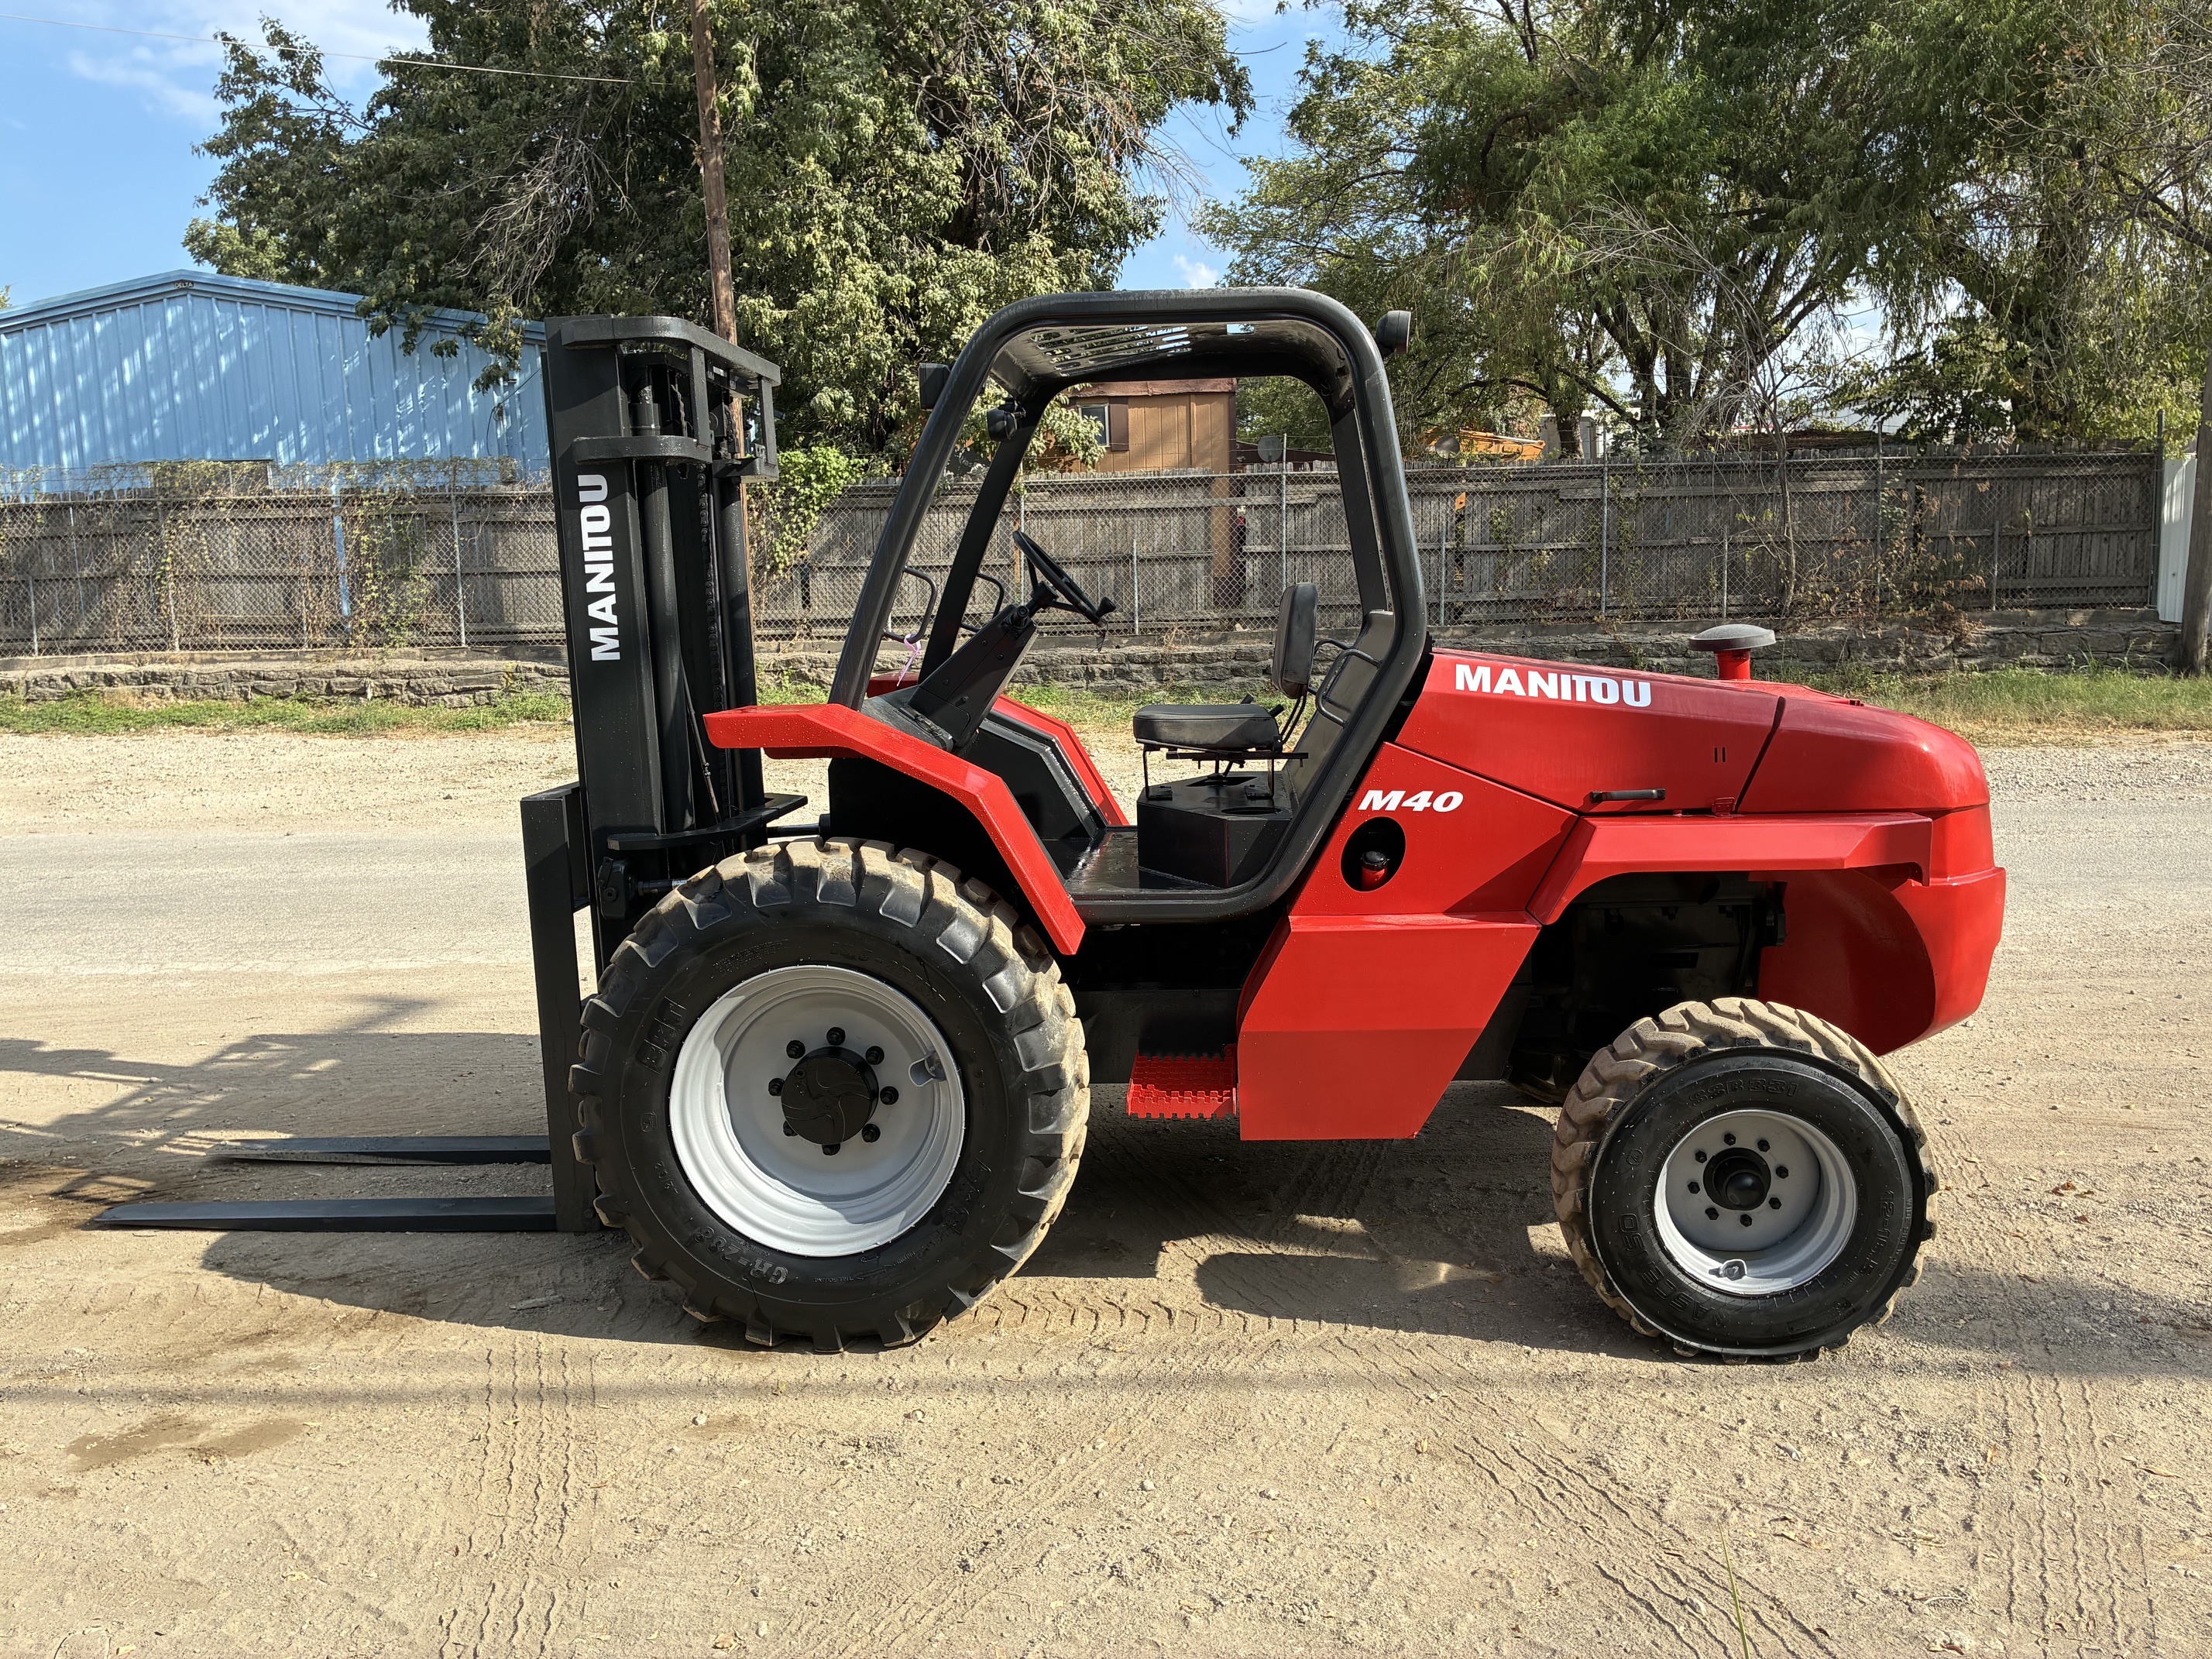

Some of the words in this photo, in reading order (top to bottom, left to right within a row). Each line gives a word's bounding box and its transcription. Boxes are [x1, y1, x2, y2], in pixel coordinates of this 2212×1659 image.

[578, 473, 620, 661] MANITOU
[1455, 664, 1652, 708] MANITOU
[1358, 789, 1464, 812] M40
[1688, 1079, 1744, 1107] SSB
[1748, 1078, 1799, 1097] 331
[693, 1225, 788, 1286] GR-288
